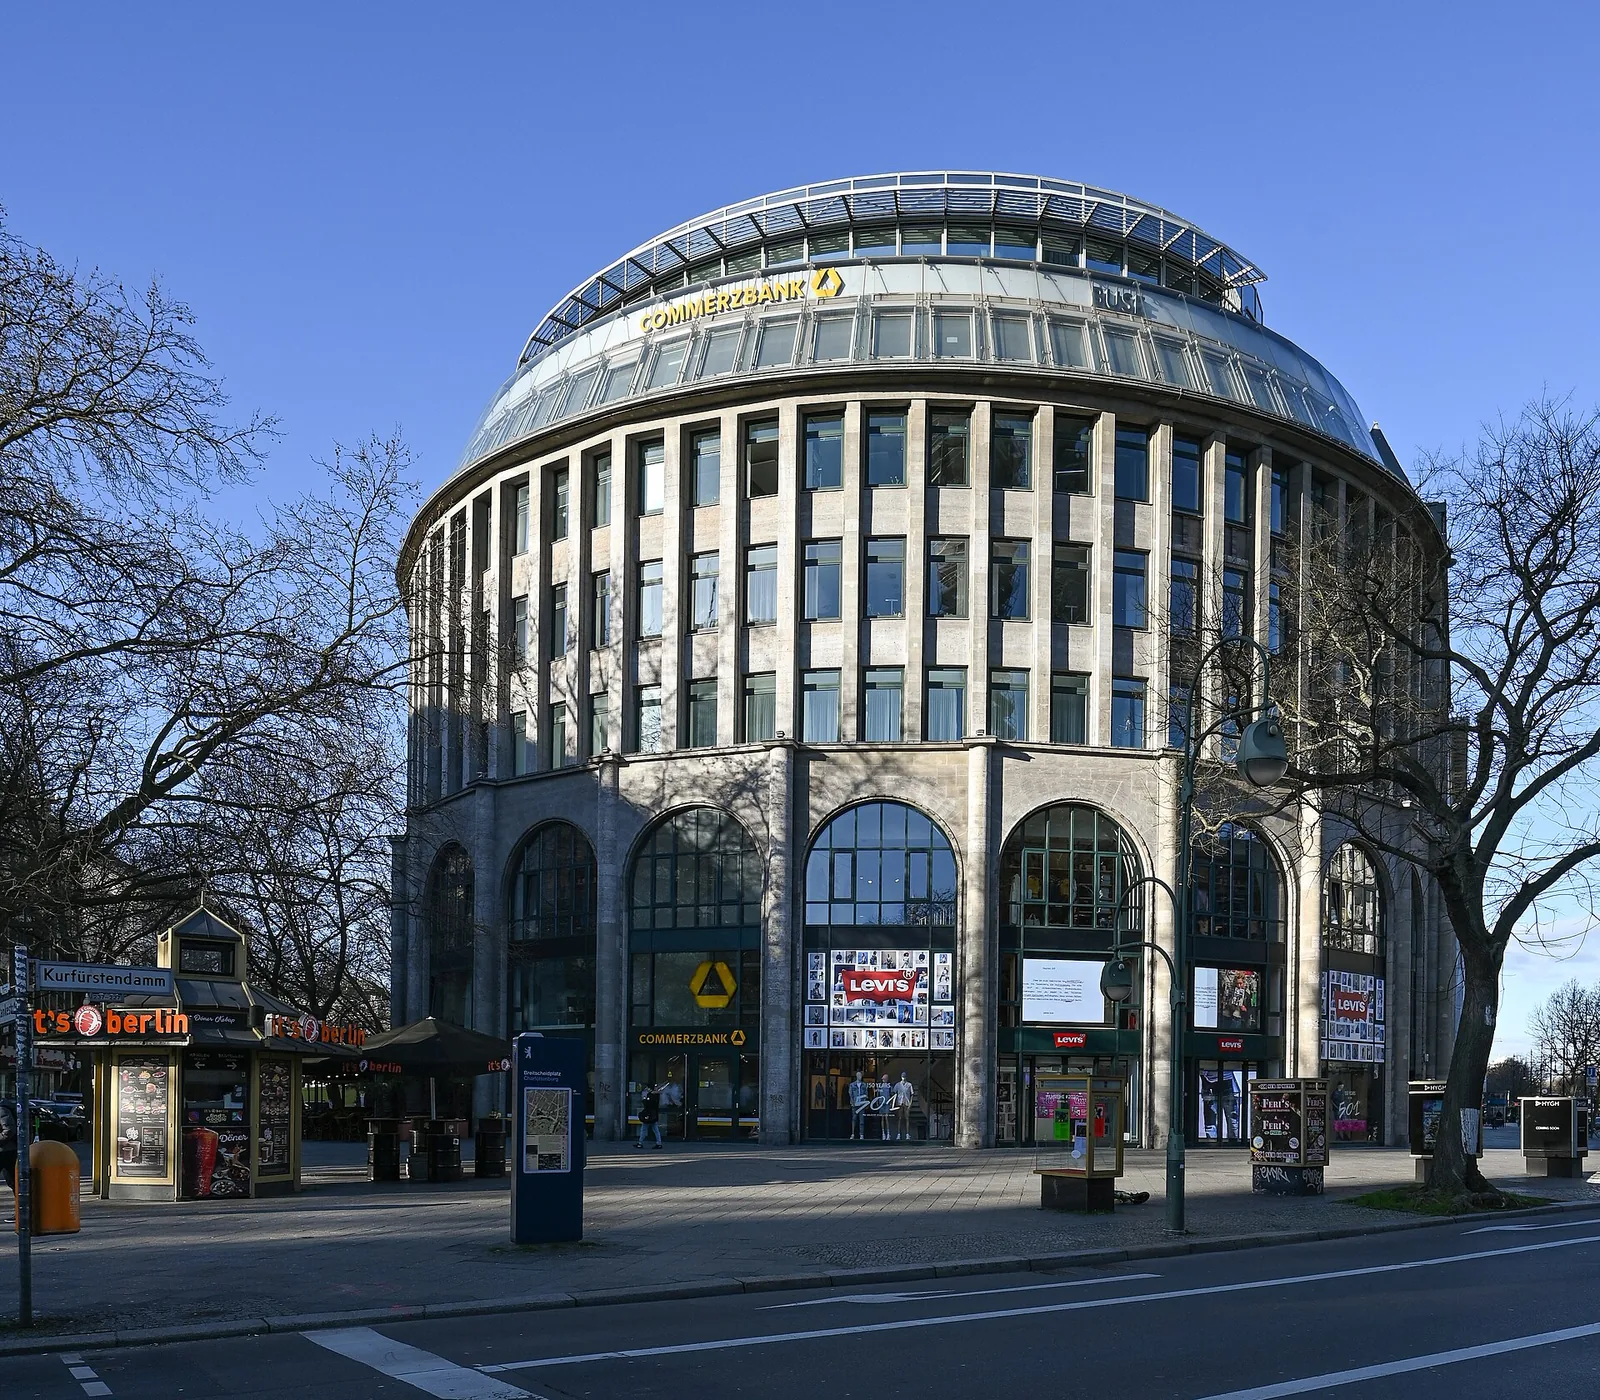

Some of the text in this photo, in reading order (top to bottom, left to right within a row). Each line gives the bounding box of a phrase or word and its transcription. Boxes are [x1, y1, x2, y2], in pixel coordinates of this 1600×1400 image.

[639, 279, 806, 333] COMMERZBANK
[44, 967, 166, 988] Kurfürstendamm
[33, 1009, 71, 1034] t's
[107, 1008, 189, 1034] berlin
[271, 1014, 367, 1047] it's berlin
[639, 1033, 728, 1044] COMMERZBANK
[342, 1061, 402, 1073] it's berlin
[487, 1060, 500, 1072] it's
[854, 1093, 901, 1114] 501
[1262, 1098, 1290, 1109] FERI'S
[1338, 1100, 1361, 1119] 501
[1262, 1120, 1290, 1130] FERI'S
